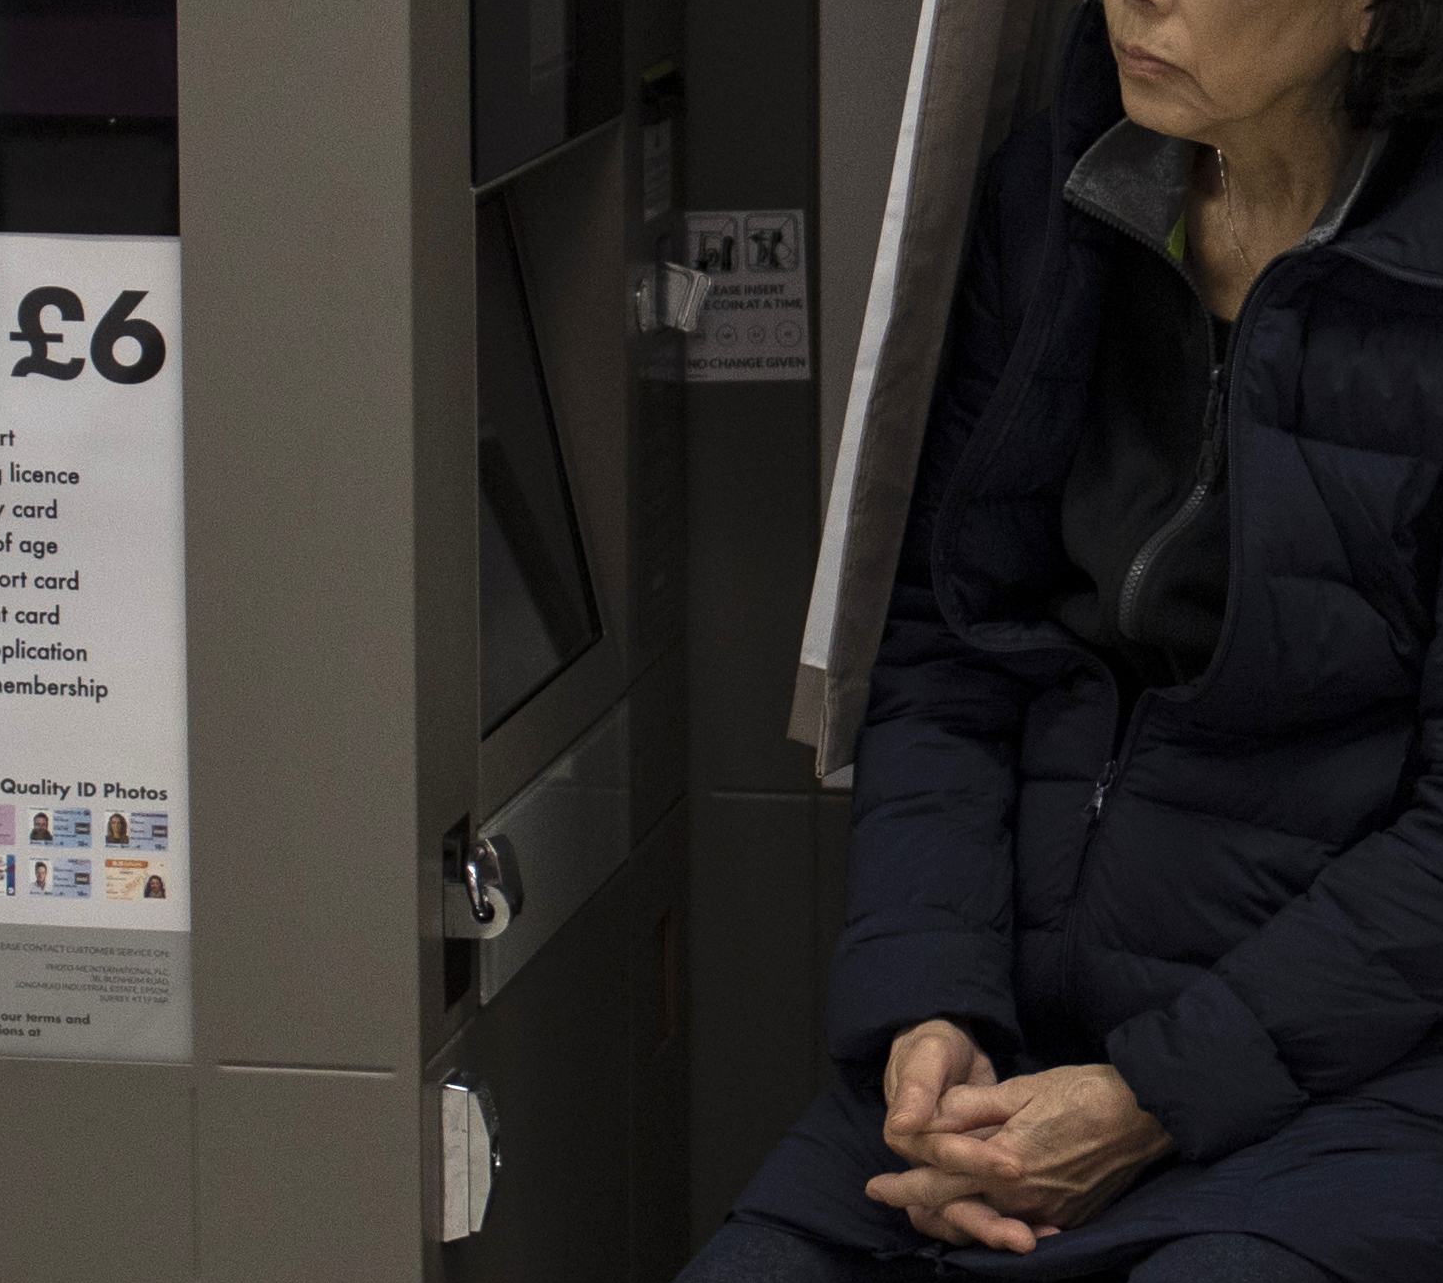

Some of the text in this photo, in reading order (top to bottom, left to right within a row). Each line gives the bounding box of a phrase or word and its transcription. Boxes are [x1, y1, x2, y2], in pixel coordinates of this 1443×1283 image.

[744, 284, 784, 294] INSERT
[712, 299, 744, 309] COIN
[745, 298, 759, 308] AT
[763, 299, 772, 308] A
[774, 298, 802, 309] TIME
[9, 284, 166, 385] £6
[686, 356, 806, 369] NO CHANGE GIVEN
[9, 460, 80, 485] licence
[11, 497, 58, 519] card
[18, 539, 58, 560] age
[33, 569, 80, 591] card
[14, 603, 60, 625] card
[0, 777, 70, 801] Quality
[76, 781, 97, 797] ID
[102, 781, 168, 801] Photos
[0, 1013, 22, 1022] our
[25, 1013, 61, 1023] terms
[65, 1012, 91, 1025] and
